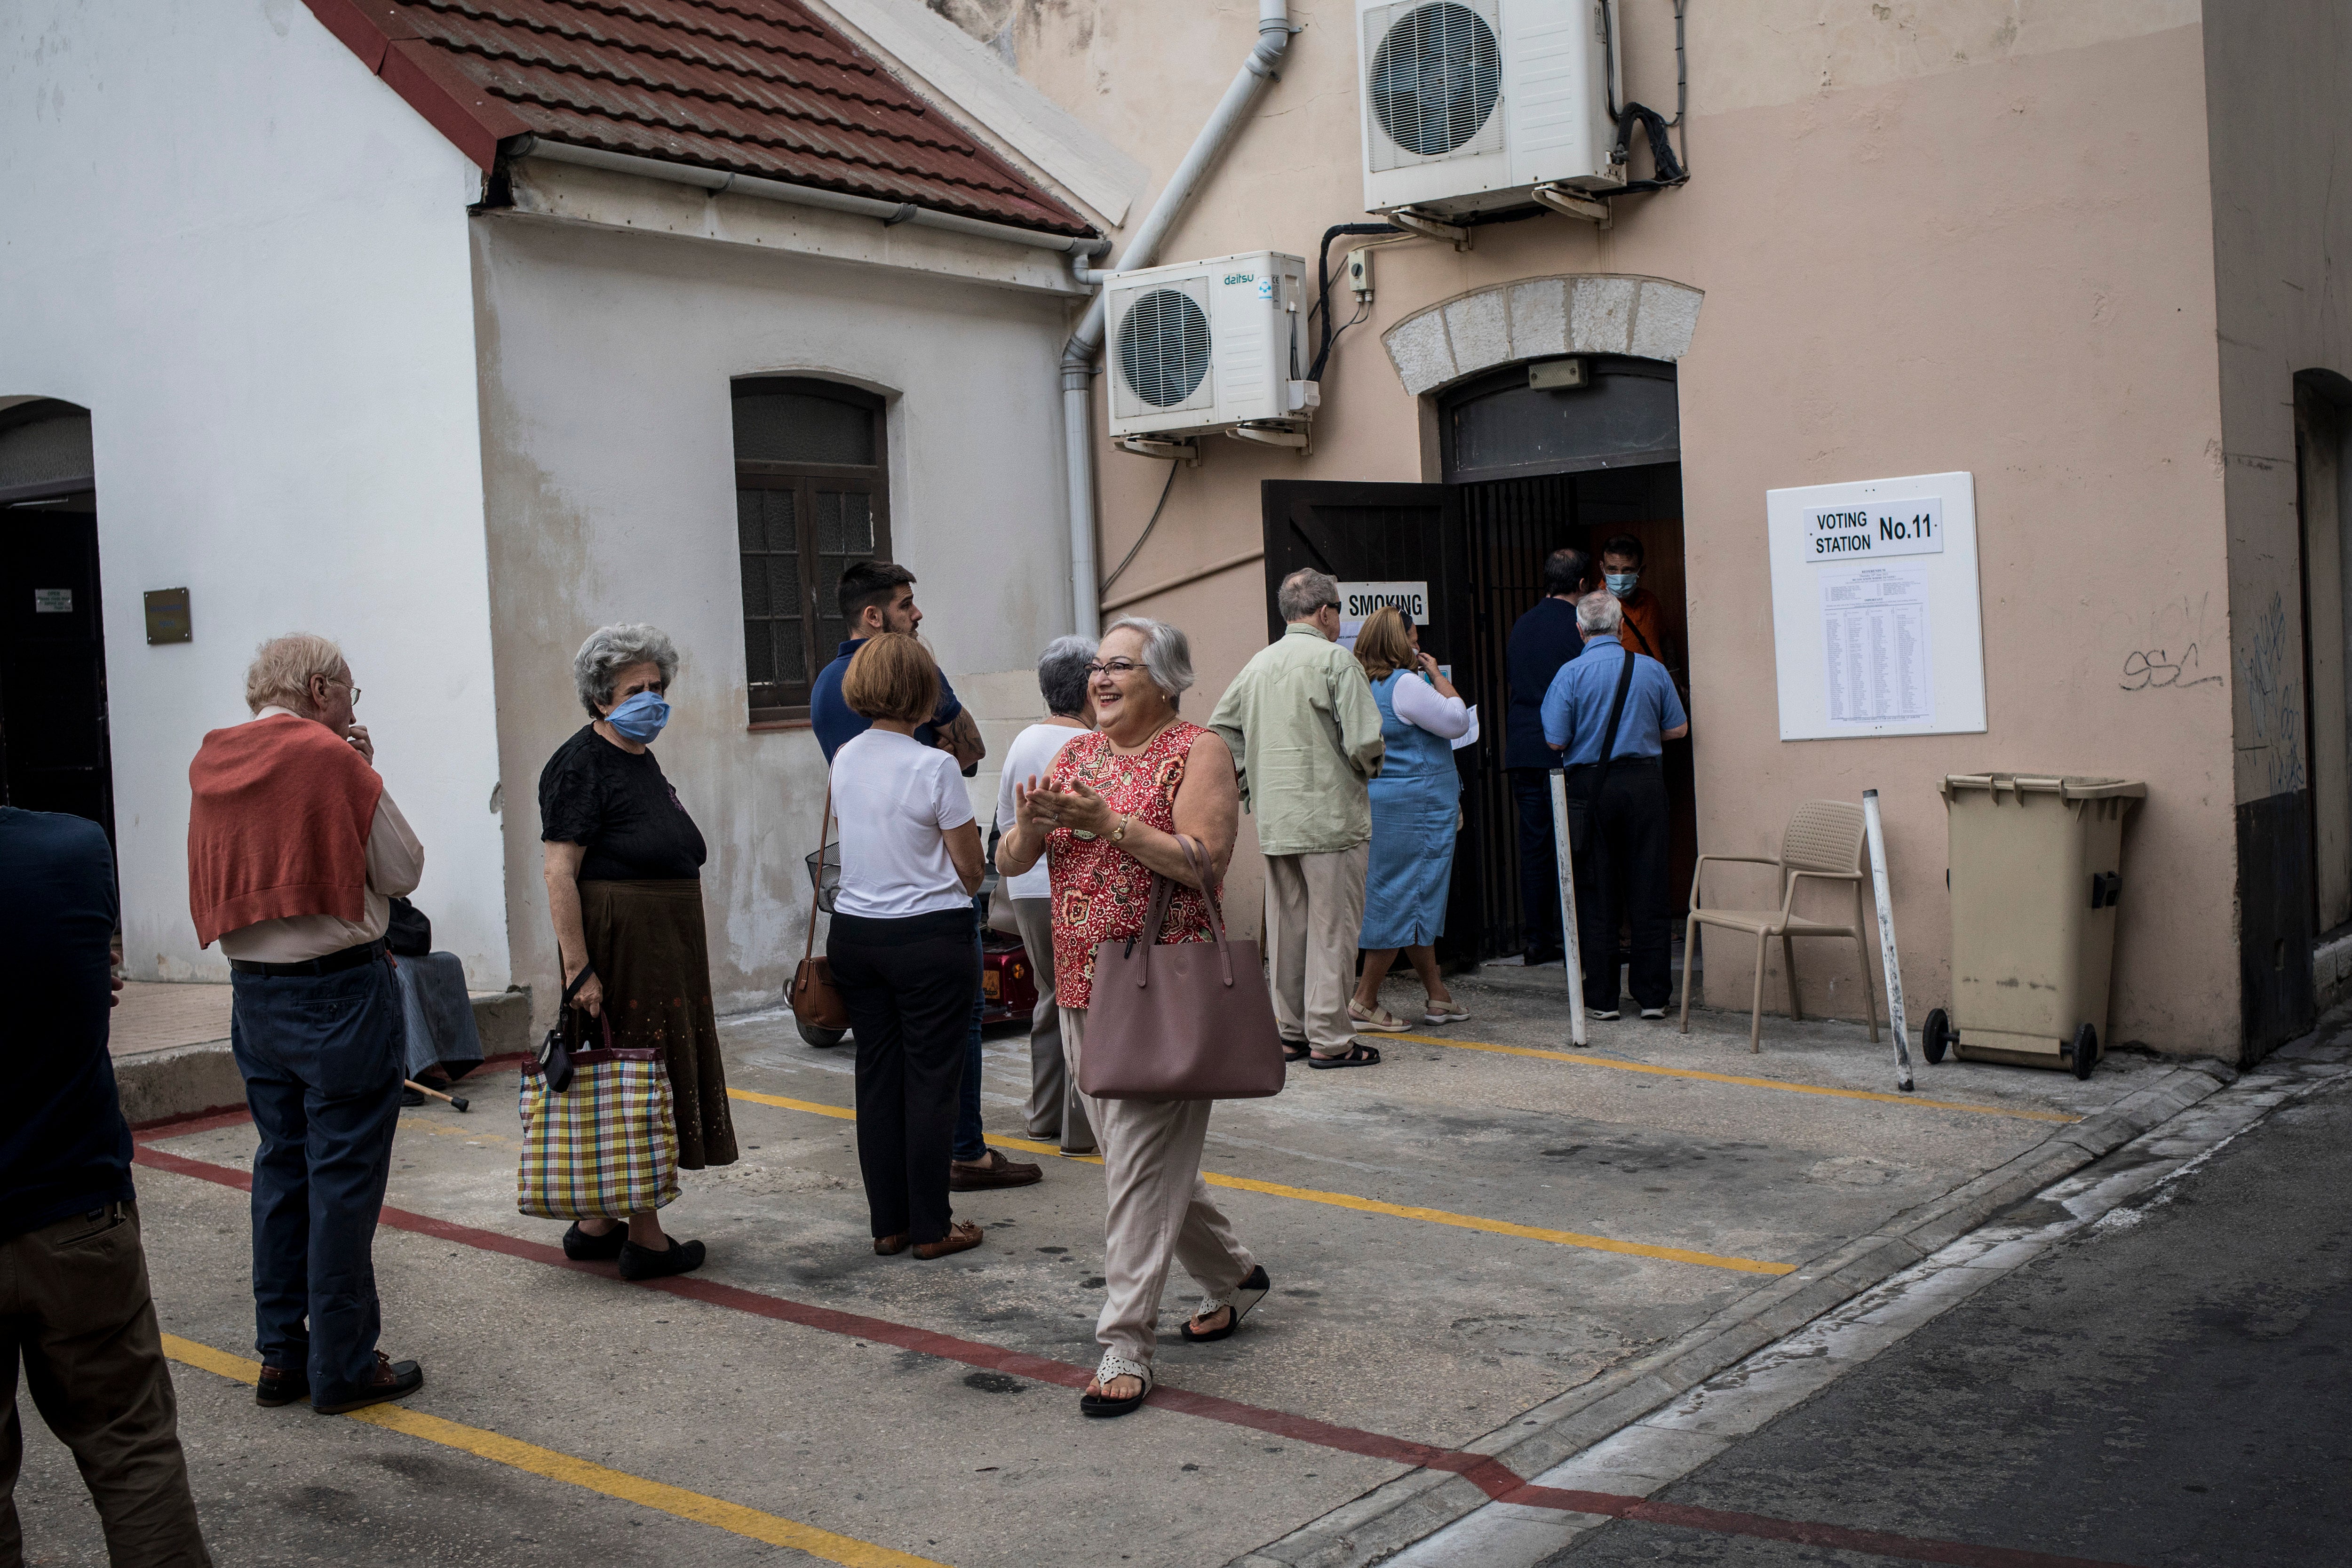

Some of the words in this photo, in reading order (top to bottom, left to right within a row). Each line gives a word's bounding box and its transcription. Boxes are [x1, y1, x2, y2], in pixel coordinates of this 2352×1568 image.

[1224, 274, 1254, 285] daitsu
[1817, 511, 1867, 530] VOTING
[1880, 514, 1931, 541] No.11
[1816, 534, 1871, 553] STATION
